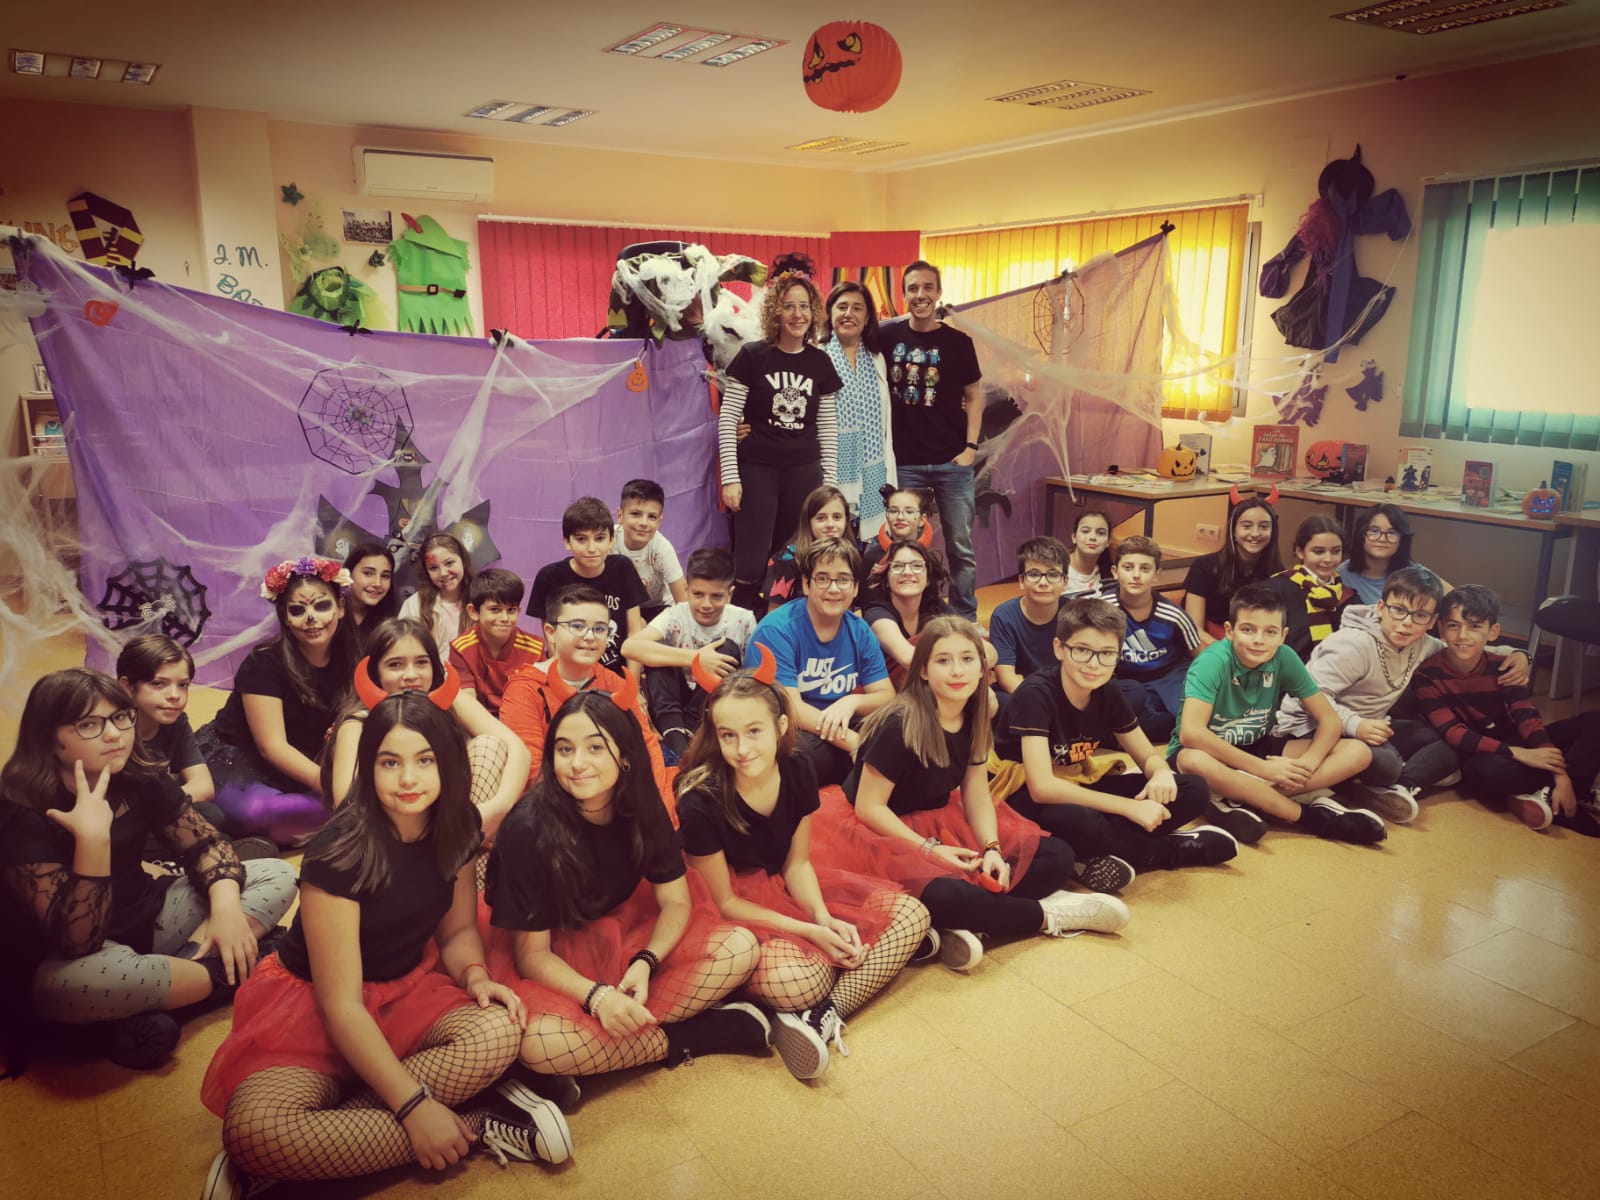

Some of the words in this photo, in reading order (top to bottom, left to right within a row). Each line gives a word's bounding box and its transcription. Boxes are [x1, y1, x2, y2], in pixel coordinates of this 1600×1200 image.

[764, 371, 813, 396] VIVA
[1120, 648, 1168, 664] didas
[803, 657, 835, 678] JUST
